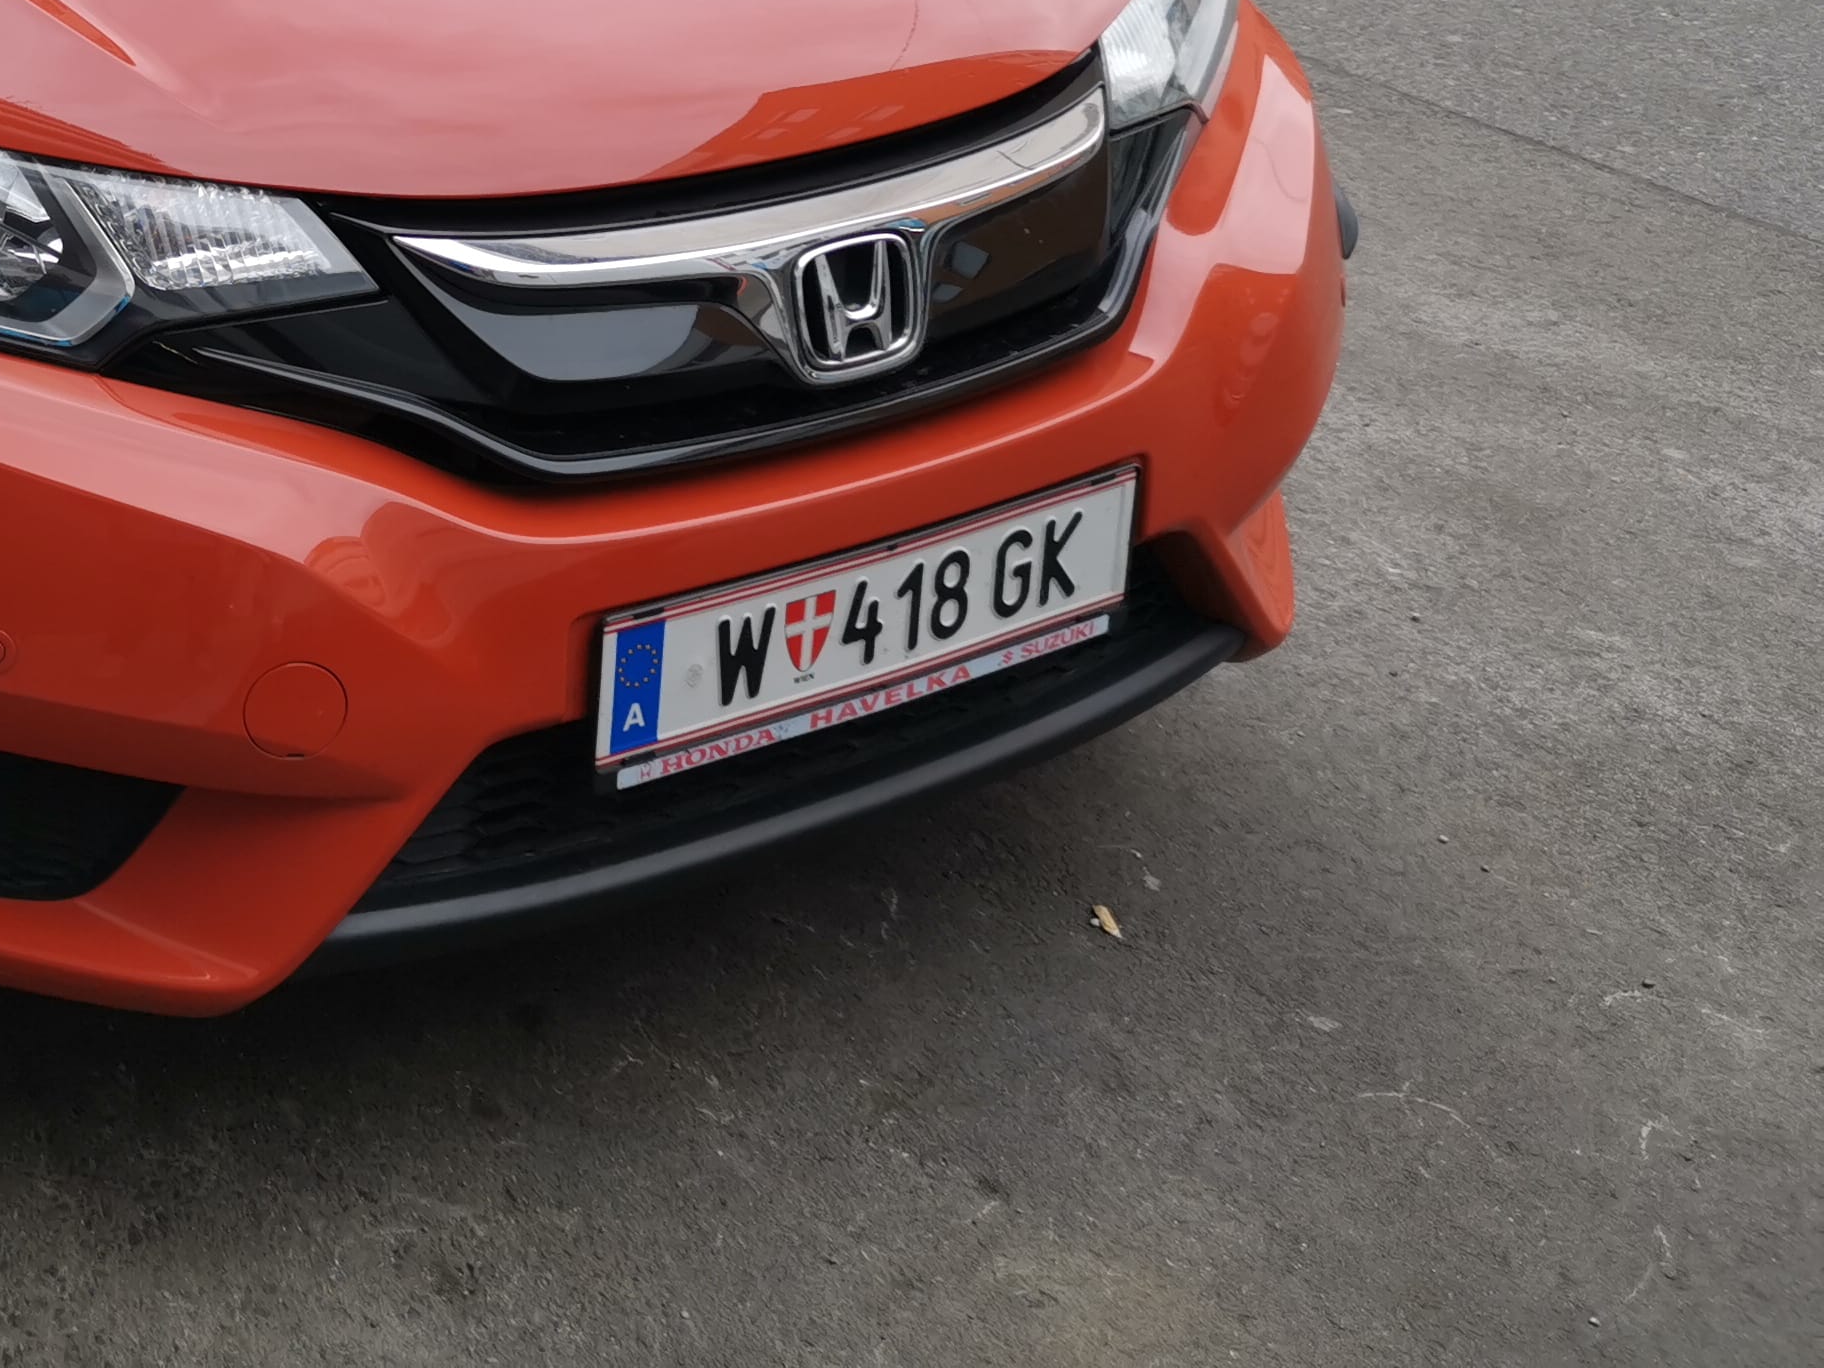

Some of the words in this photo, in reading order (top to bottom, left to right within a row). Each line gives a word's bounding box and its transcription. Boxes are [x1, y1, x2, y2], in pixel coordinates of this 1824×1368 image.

[718, 606, 776, 707] W
[842, 549, 971, 665] 418
[992, 510, 1084, 619] GK
[623, 702, 646, 732] A
[660, 727, 777, 775] HONDA
[809, 665, 972, 729] HAVELKA
[1019, 621, 1098, 659] SUZUKI
